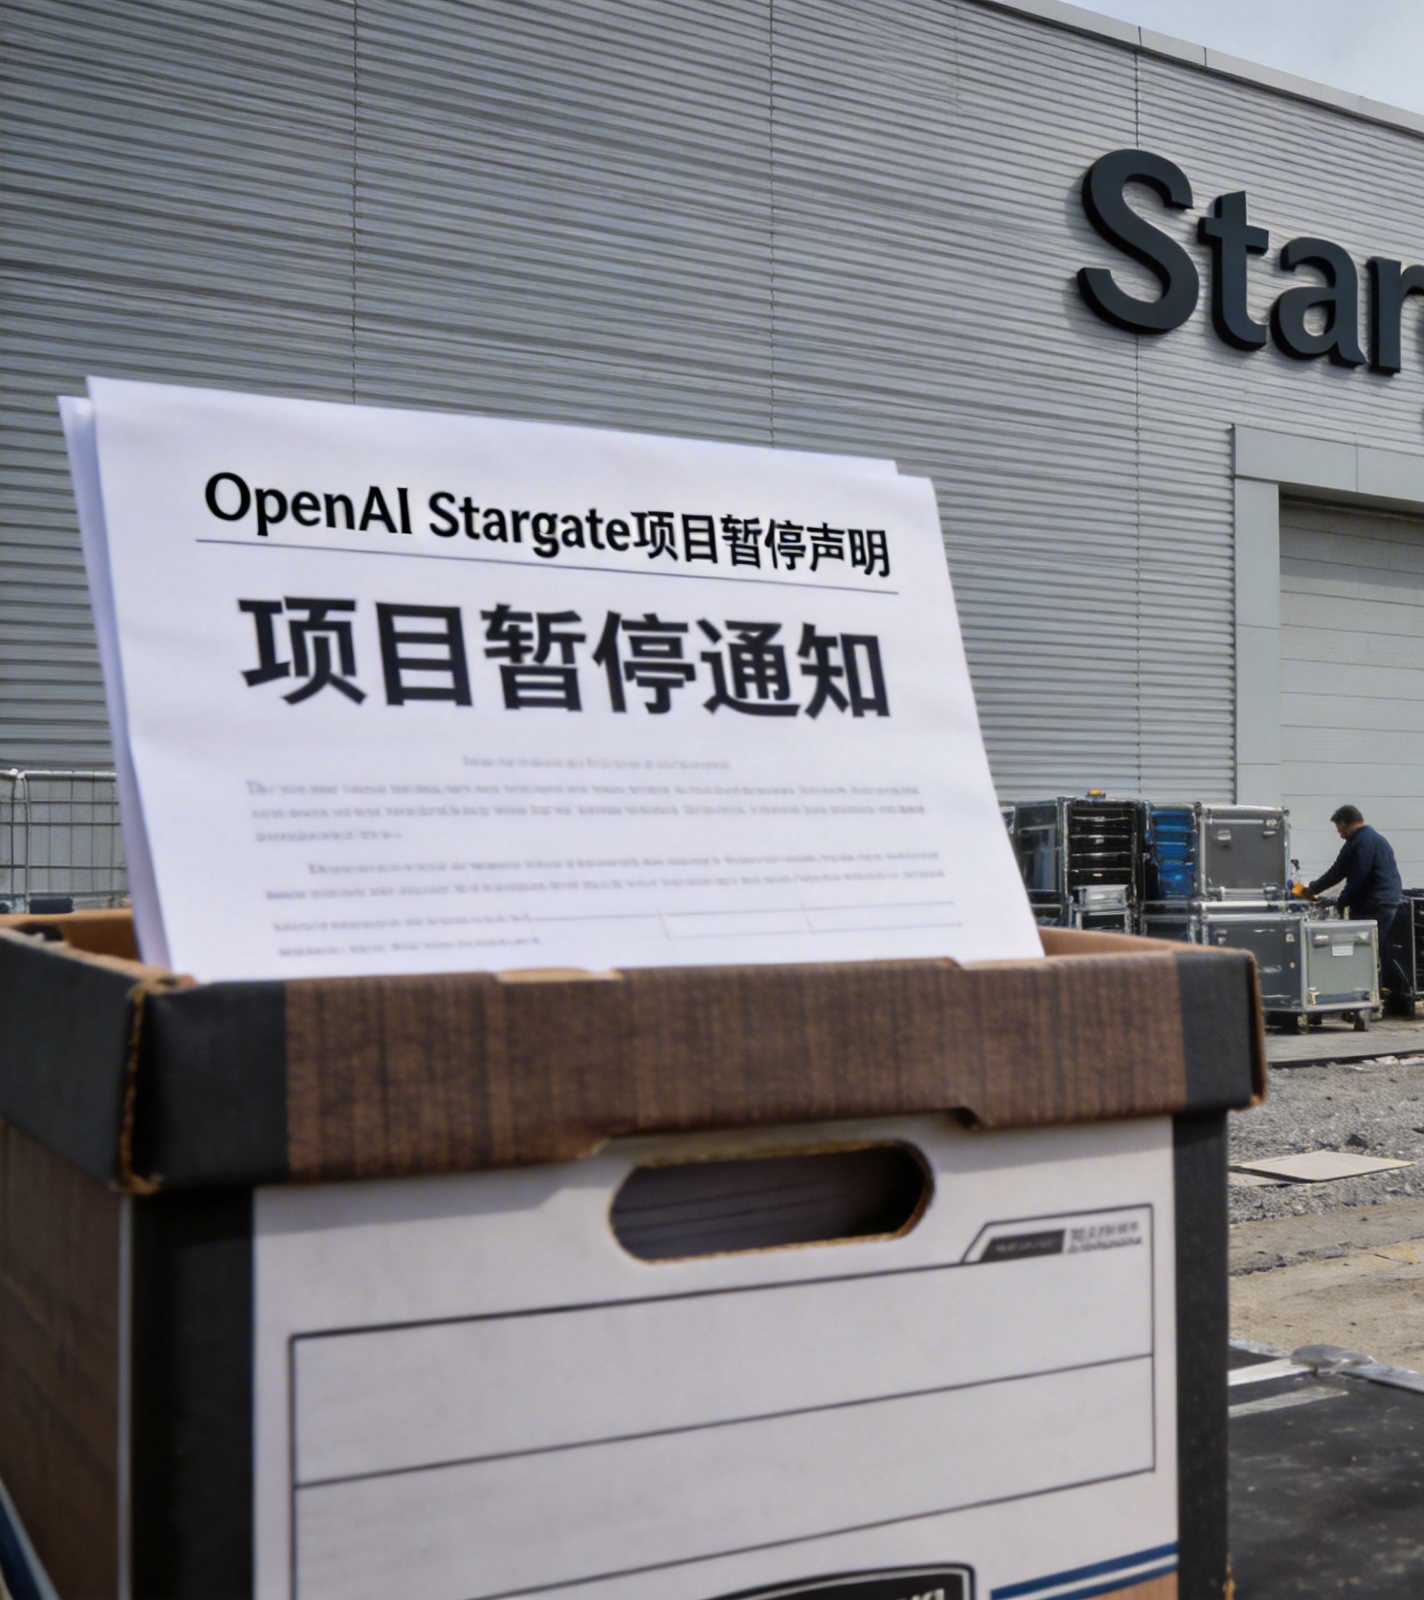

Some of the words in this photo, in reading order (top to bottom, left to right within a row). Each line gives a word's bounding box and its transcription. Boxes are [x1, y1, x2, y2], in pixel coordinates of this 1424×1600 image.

[205, 472, 412, 536] OpenAI
[237, 596, 890, 720] 项目暂停通知
